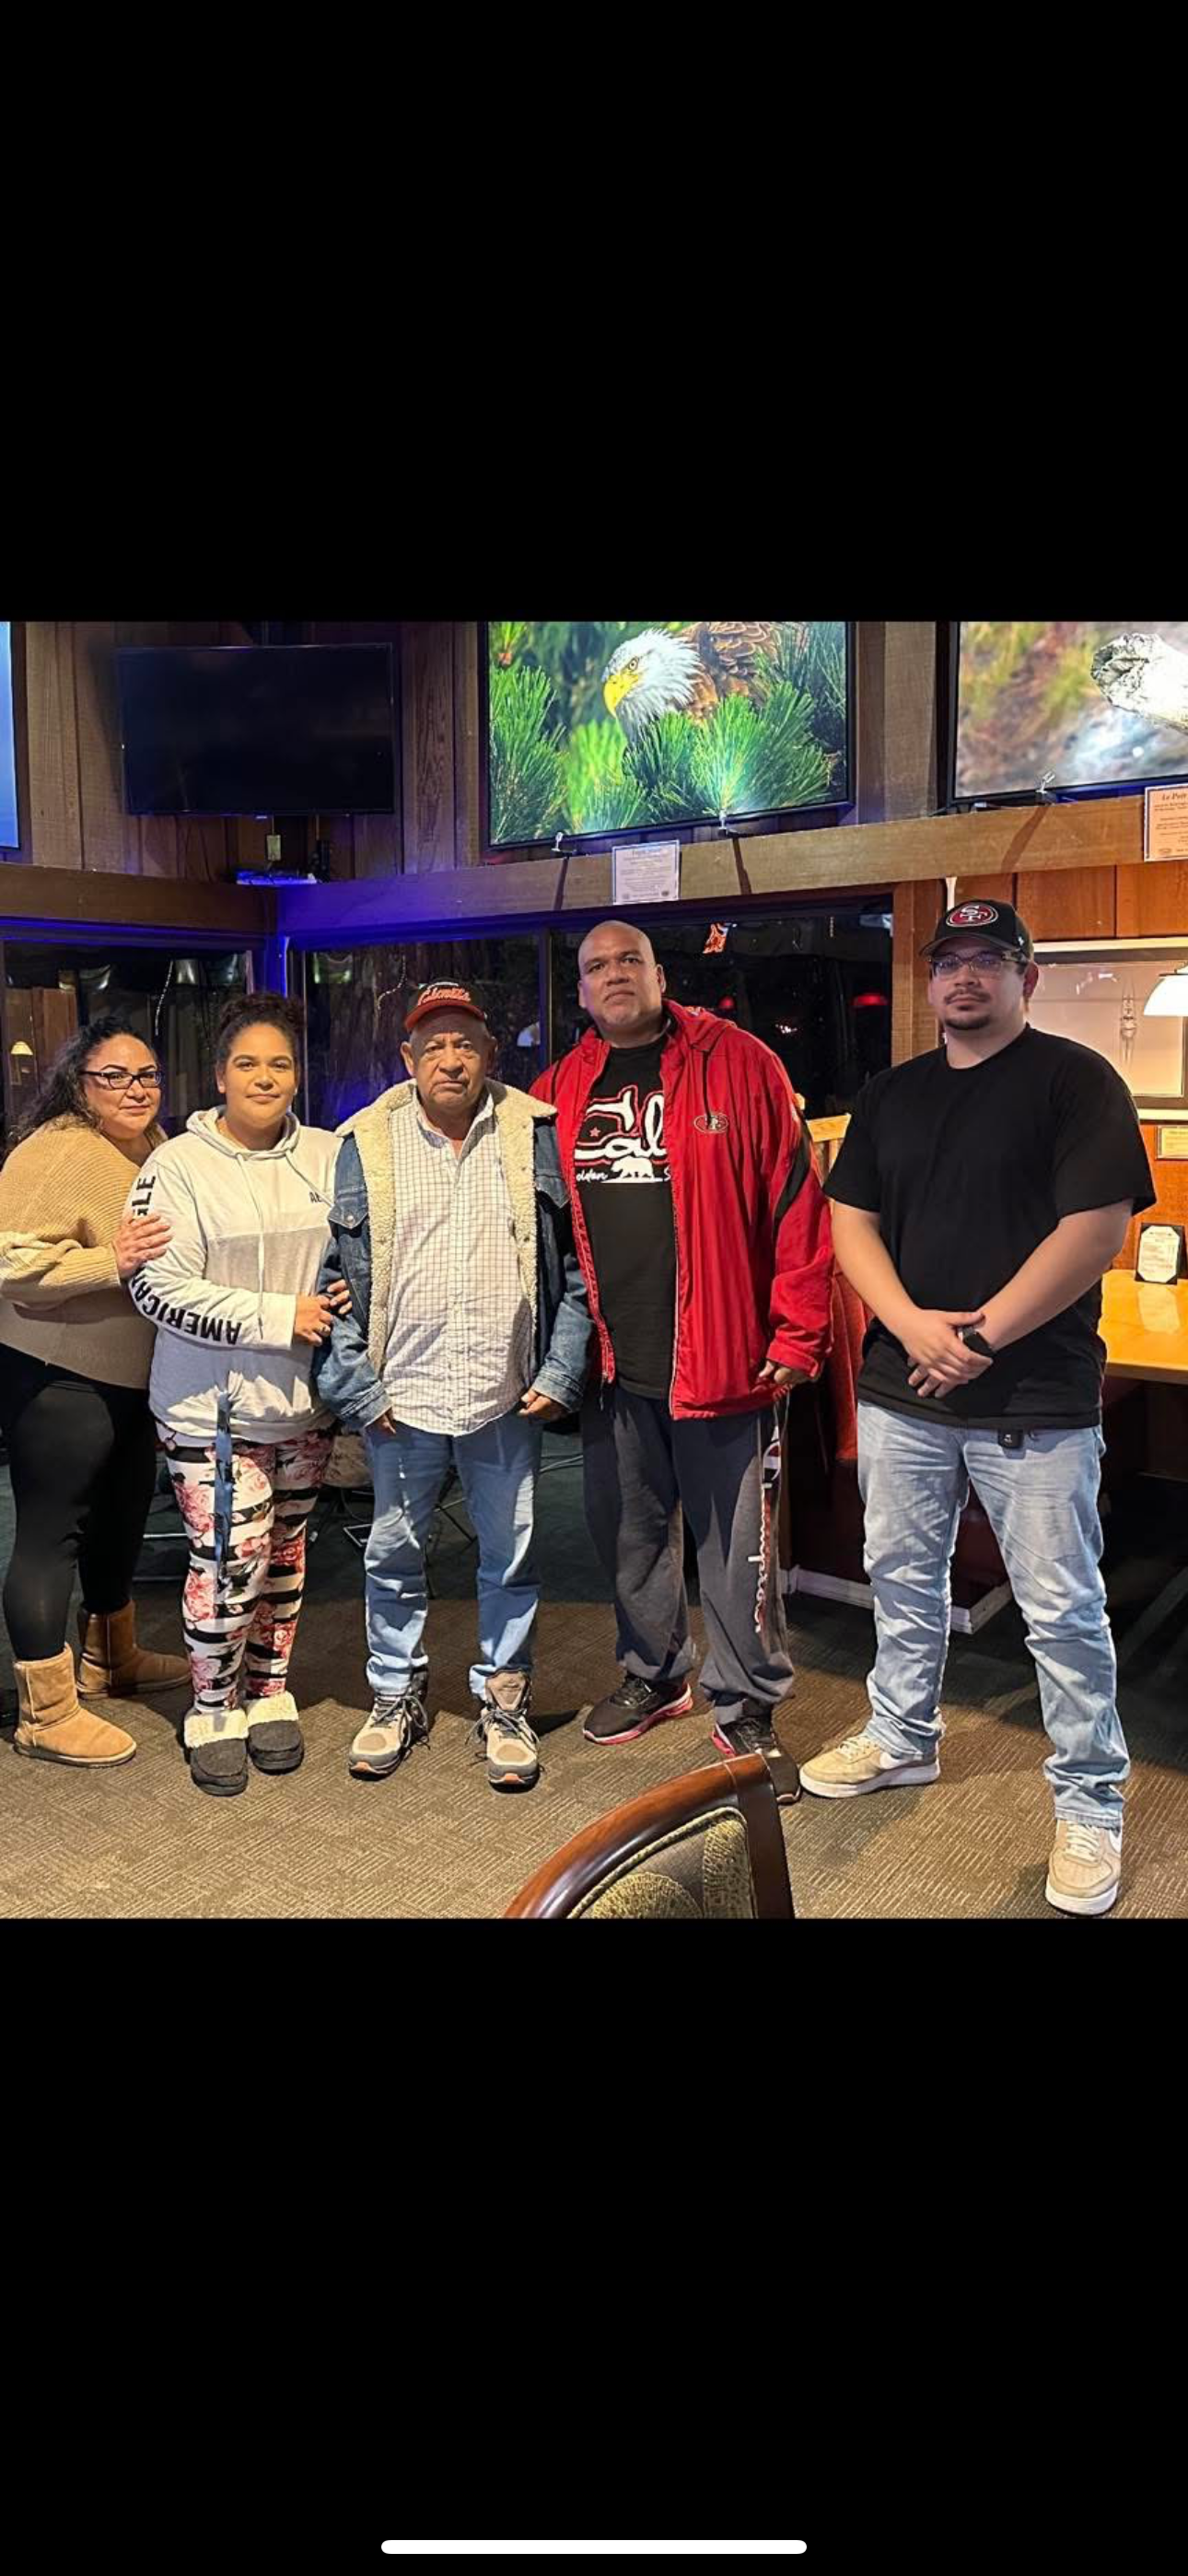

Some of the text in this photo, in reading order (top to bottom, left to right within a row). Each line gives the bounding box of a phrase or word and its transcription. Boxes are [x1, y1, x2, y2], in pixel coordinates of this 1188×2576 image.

[960, 906, 988, 922] SF
[575, 1090, 668, 1160] Cal
[577, 1168, 609, 1182] olden
